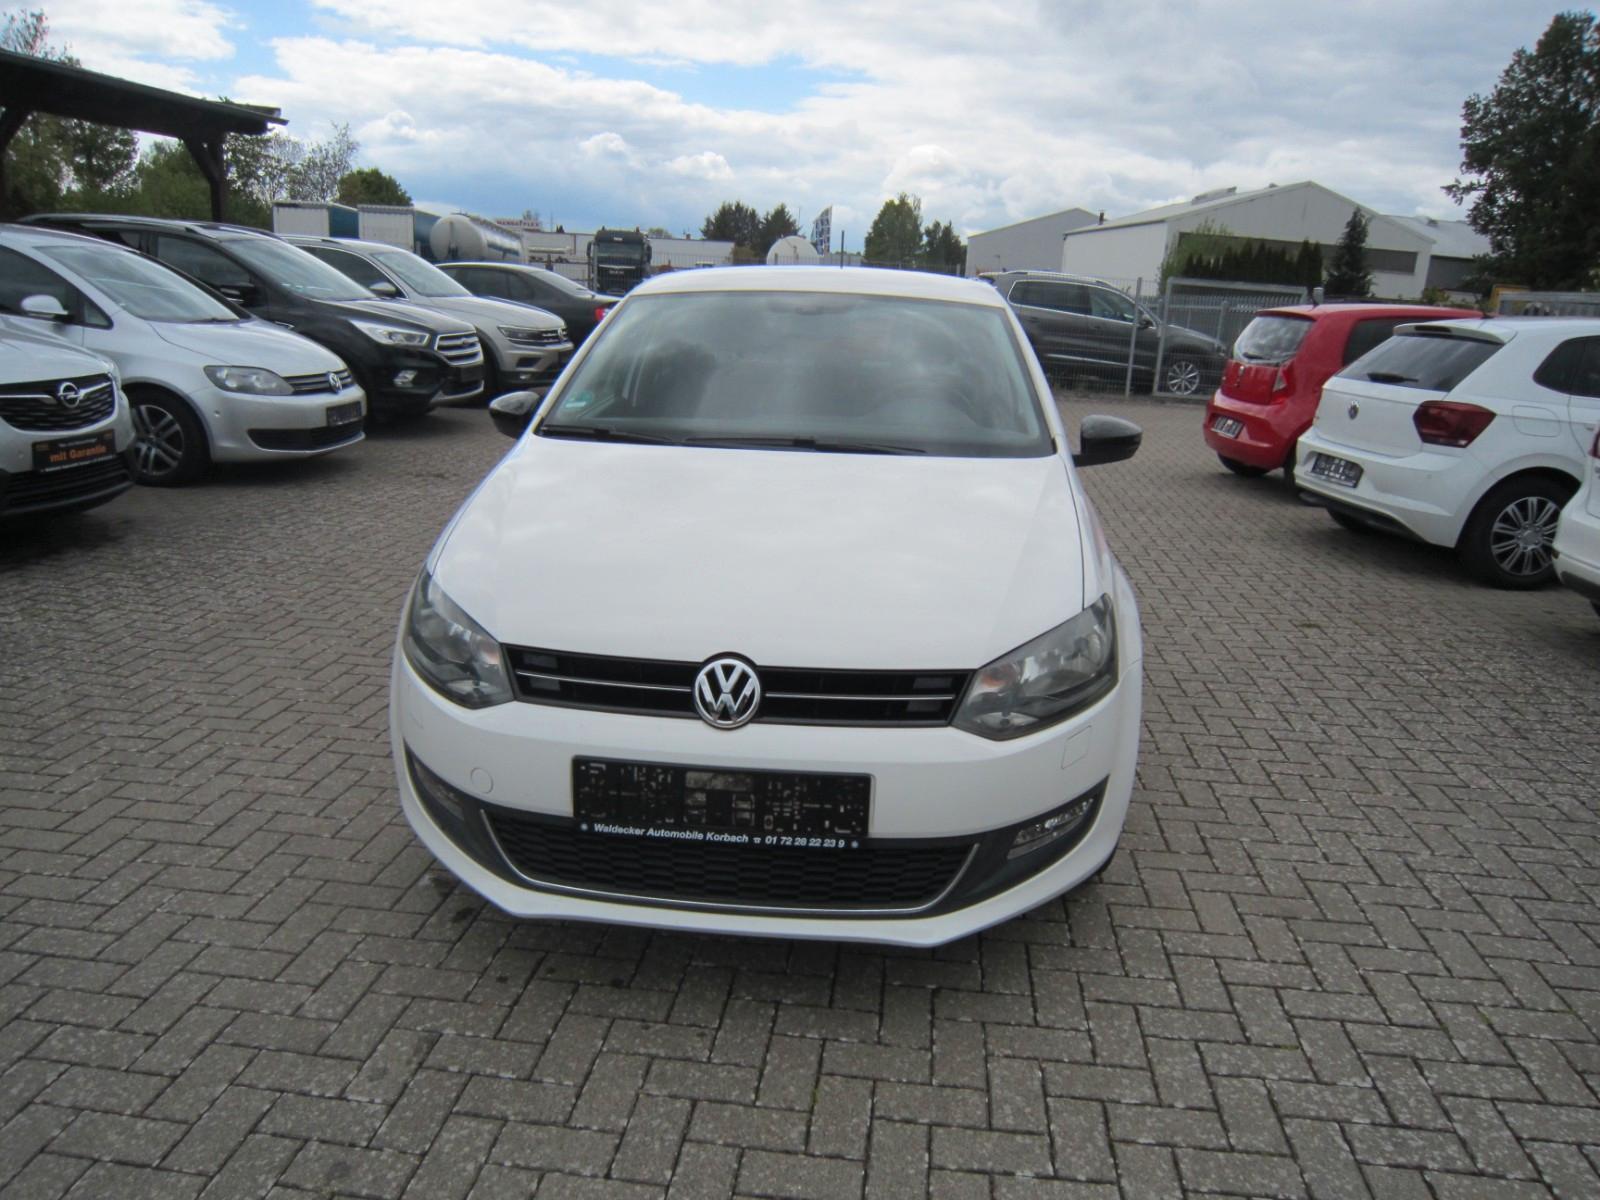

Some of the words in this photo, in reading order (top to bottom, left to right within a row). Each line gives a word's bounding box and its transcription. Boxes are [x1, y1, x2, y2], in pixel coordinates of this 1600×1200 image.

[594, 823, 645, 836] Waldecker
[646, 827, 704, 840] Automobile
[705, 831, 748, 843] Korbach
[765, 835, 778, 845] 01
[780, 836, 793, 846] 72
[809, 838, 822, 847] 22
[823, 838, 836, 848] 23
[838, 839, 846, 848] 9
